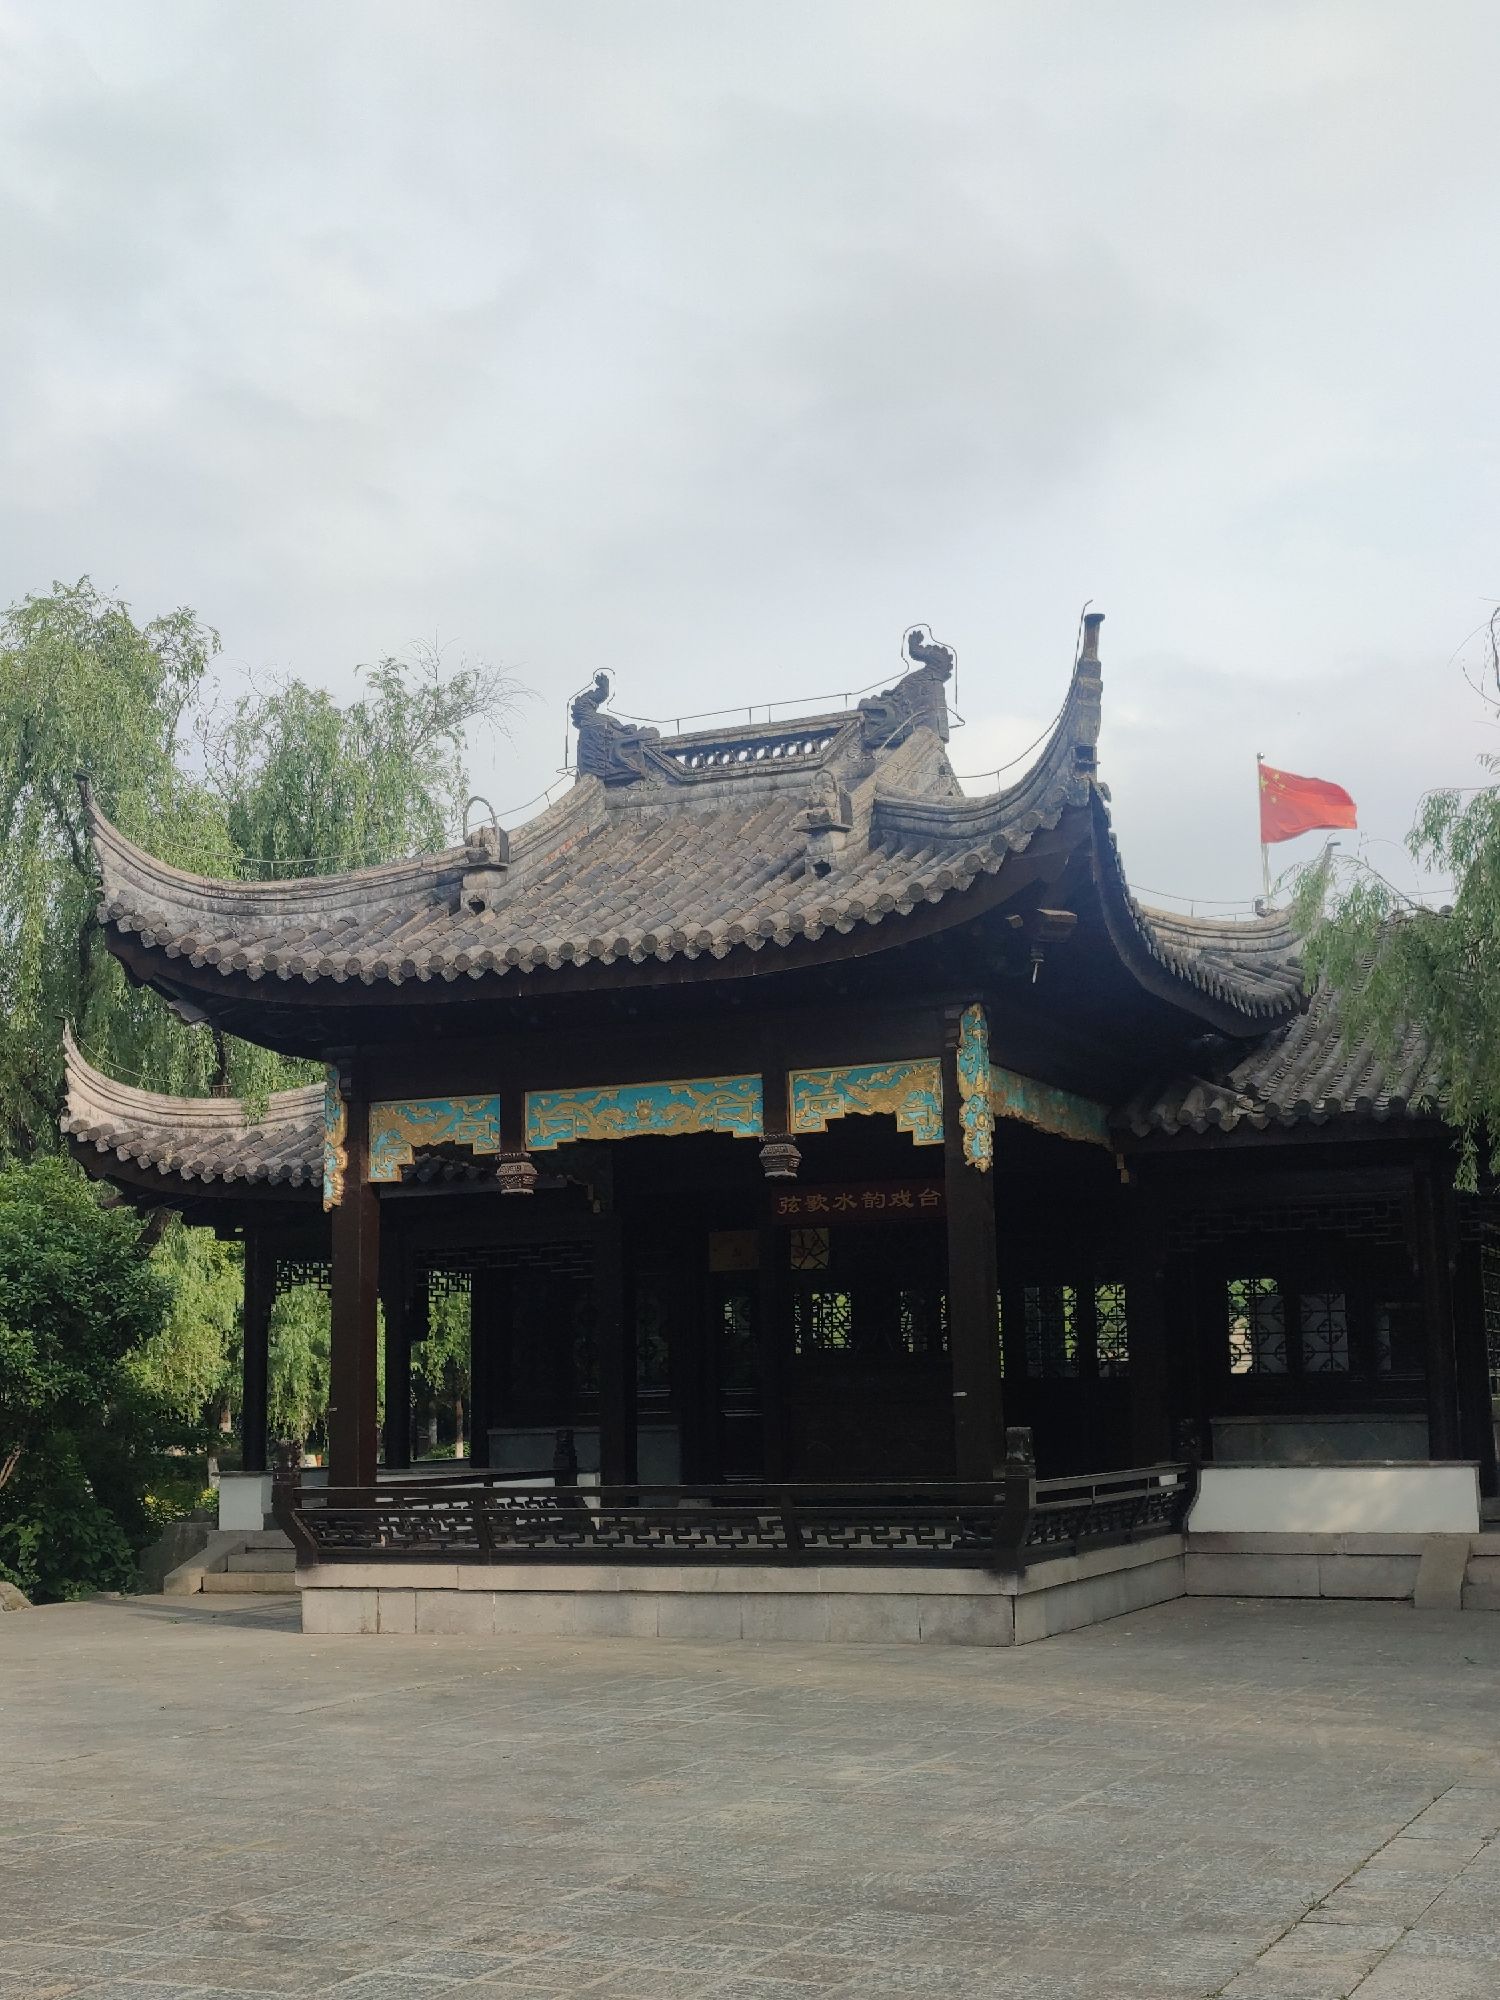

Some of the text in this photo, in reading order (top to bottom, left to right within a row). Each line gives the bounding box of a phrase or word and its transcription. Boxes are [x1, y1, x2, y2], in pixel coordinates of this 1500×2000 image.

[777, 1188, 942, 1215] 弦歌水韵戏台
